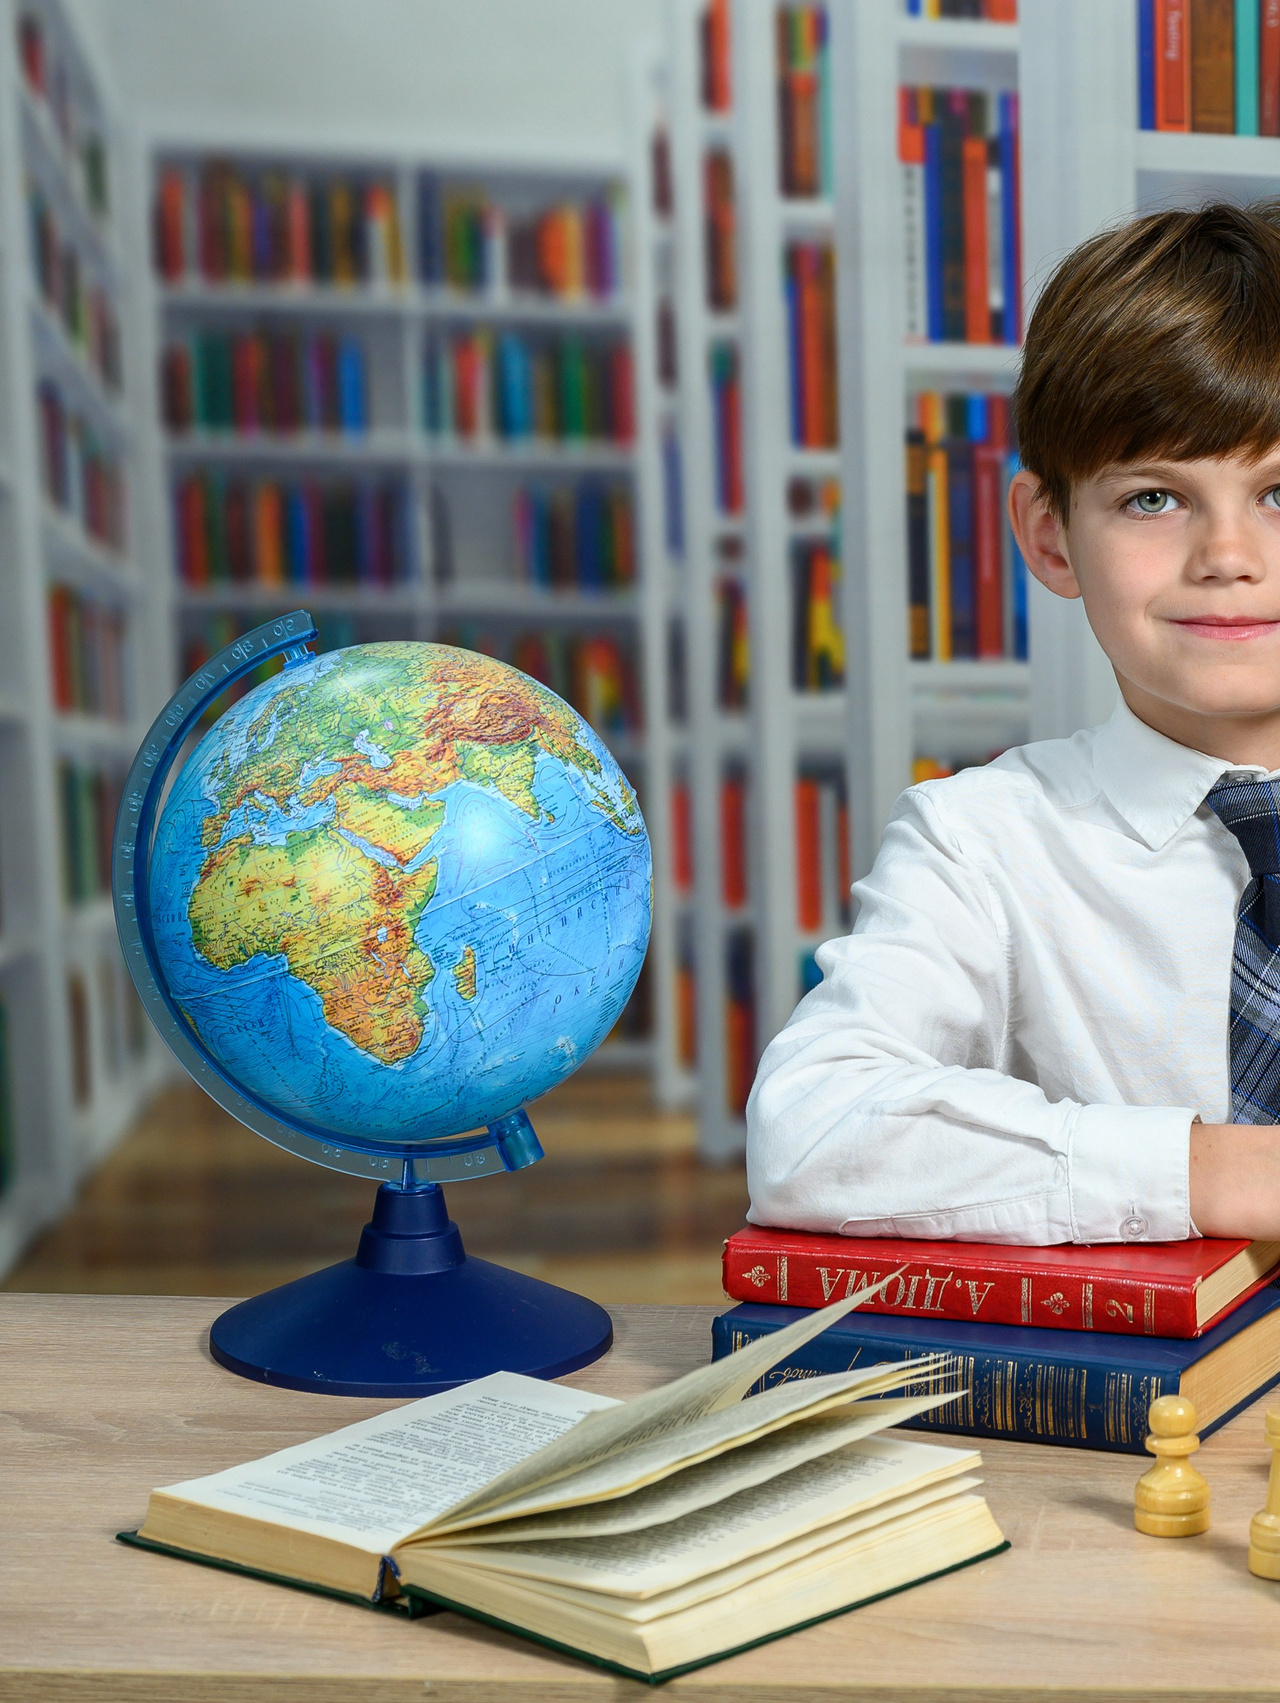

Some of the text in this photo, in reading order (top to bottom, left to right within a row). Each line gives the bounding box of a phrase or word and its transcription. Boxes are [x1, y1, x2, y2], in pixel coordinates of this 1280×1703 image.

[815, 1266, 995, 1315] А. ДЮМА
[1105, 1298, 1134, 1324] 2
